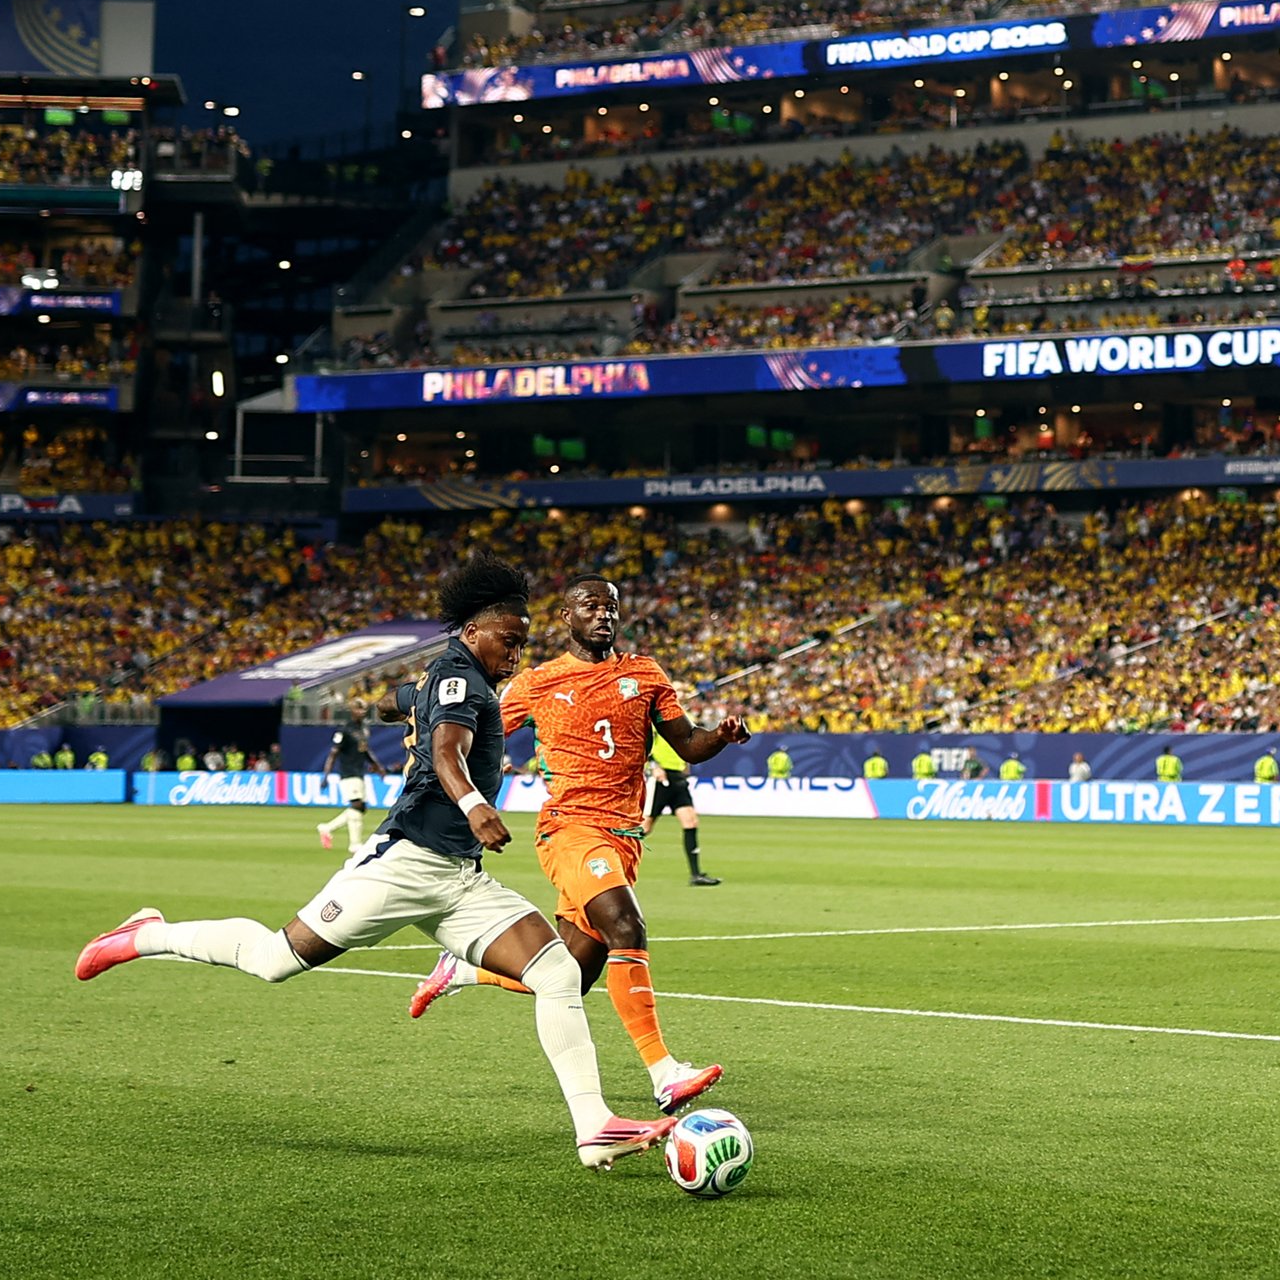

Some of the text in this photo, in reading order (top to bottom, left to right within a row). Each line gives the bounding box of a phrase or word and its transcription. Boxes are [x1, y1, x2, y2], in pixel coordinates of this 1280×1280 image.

[827, 22, 1067, 65] FIFA WORLD CUP 2026
[555, 58, 691, 88] PHILADELPHIA
[982, 332, 1061, 378] FIFA
[1066, 331, 1204, 374] WORLD
[423, 363, 650, 402] PHILADELPHIA
[644, 476, 825, 496] PHILADELPHIA
[593, 719, 615, 759] 3
[169, 771, 270, 806] Michelob
[906, 778, 1027, 820] Michelob
[1060, 783, 1187, 822] ULTRA
